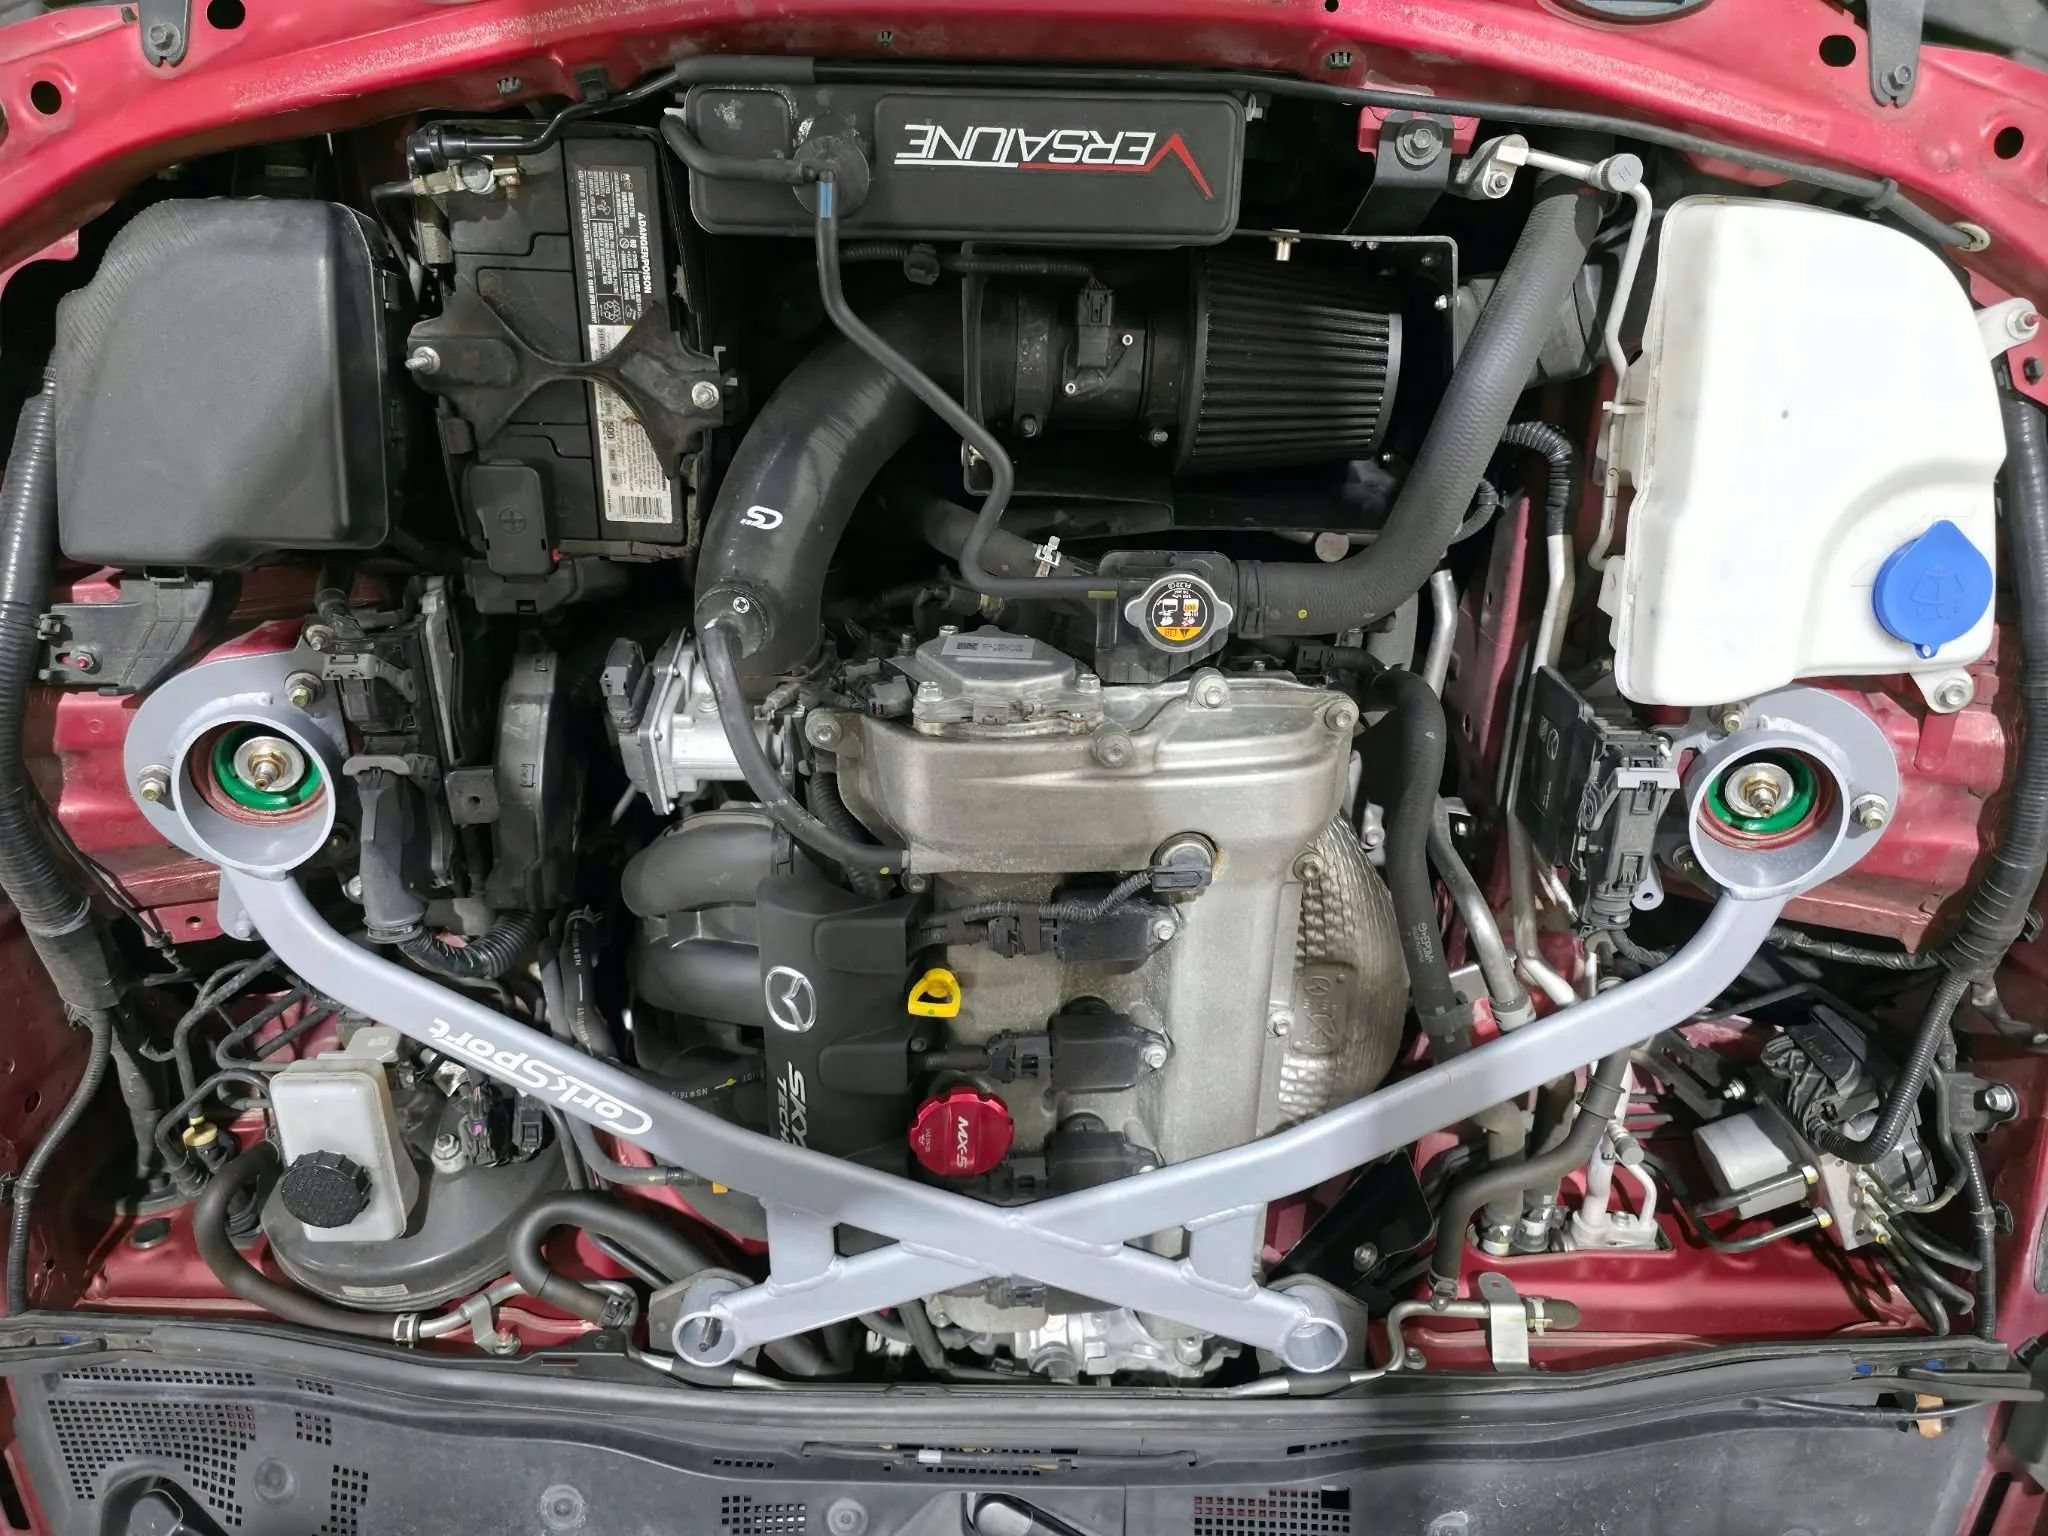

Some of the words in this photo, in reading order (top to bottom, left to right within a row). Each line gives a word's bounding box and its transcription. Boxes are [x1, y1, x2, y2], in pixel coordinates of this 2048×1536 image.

[894, 124, 1214, 198] VERSATUNE
[637, 220, 651, 293] DANGER/POISON
[605, 421, 615, 439] 500
[428, 1018, 652, 1135] CorkSport
[777, 1076, 790, 1143] TECH
[956, 1116, 969, 1169] MX-5
